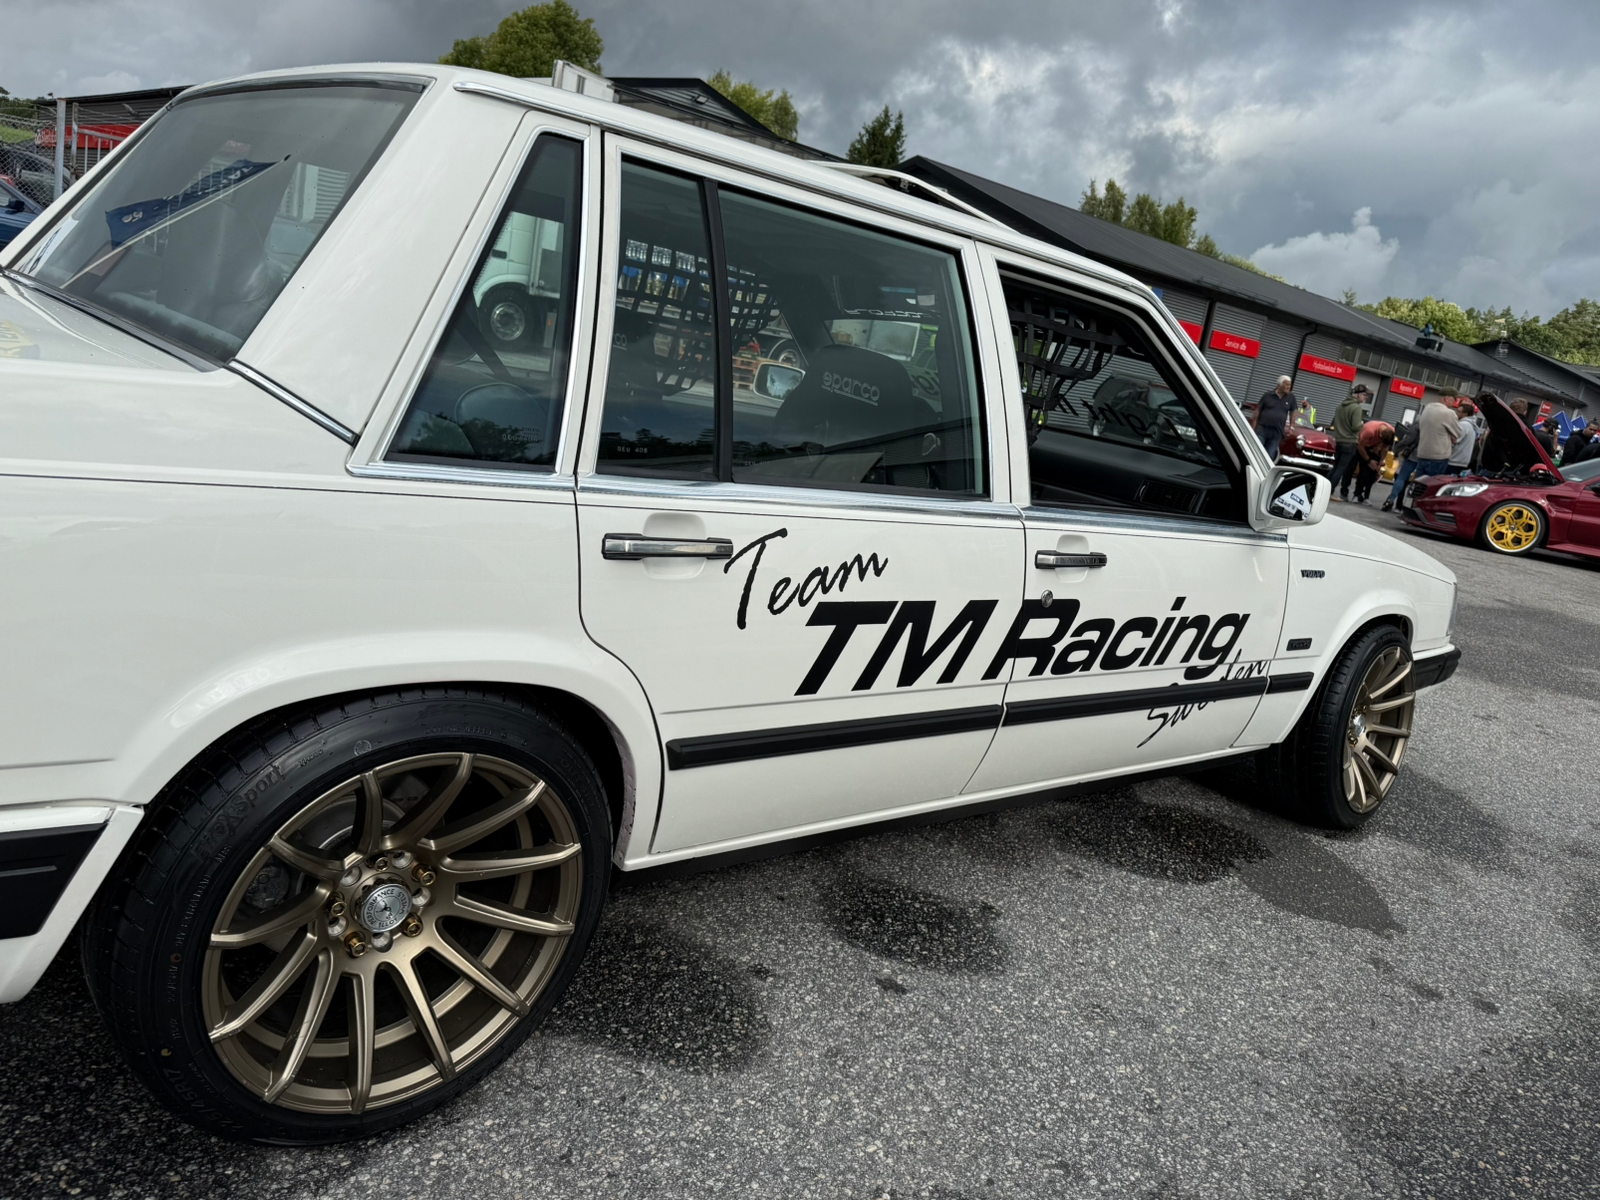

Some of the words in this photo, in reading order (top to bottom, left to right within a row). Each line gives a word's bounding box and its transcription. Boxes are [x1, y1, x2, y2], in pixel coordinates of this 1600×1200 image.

[822, 371, 880, 402] sparco
[724, 528, 888, 630] Team
[1301, 569, 1325, 579] VOLVO
[794, 600, 999, 696] TM
[981, 596, 1251, 680] Racing
